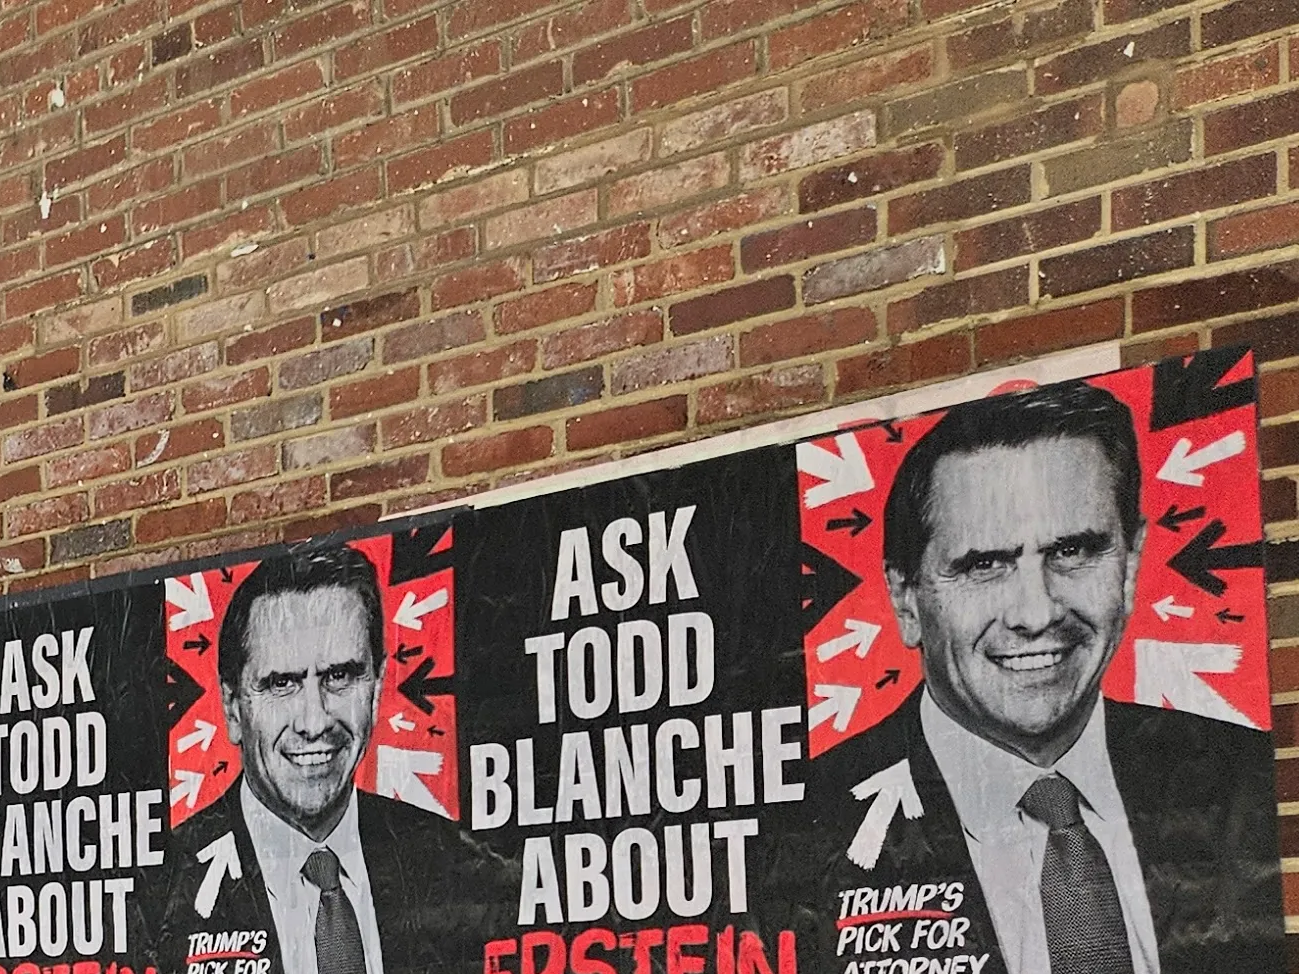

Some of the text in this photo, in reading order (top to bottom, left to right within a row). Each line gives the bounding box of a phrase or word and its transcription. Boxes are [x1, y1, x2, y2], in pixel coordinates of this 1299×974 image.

[551, 504, 699, 621] ASK
[0, 627, 95, 715] ASK
[525, 611, 714, 724] TODD
[469, 705, 805, 830] BLANCHE
[517, 818, 758, 926] ABOUT
[838, 882, 964, 920] TRUMP'S
[187, 930, 267, 958] TRUMP'S
[836, 917, 970, 956] PICK FOR
